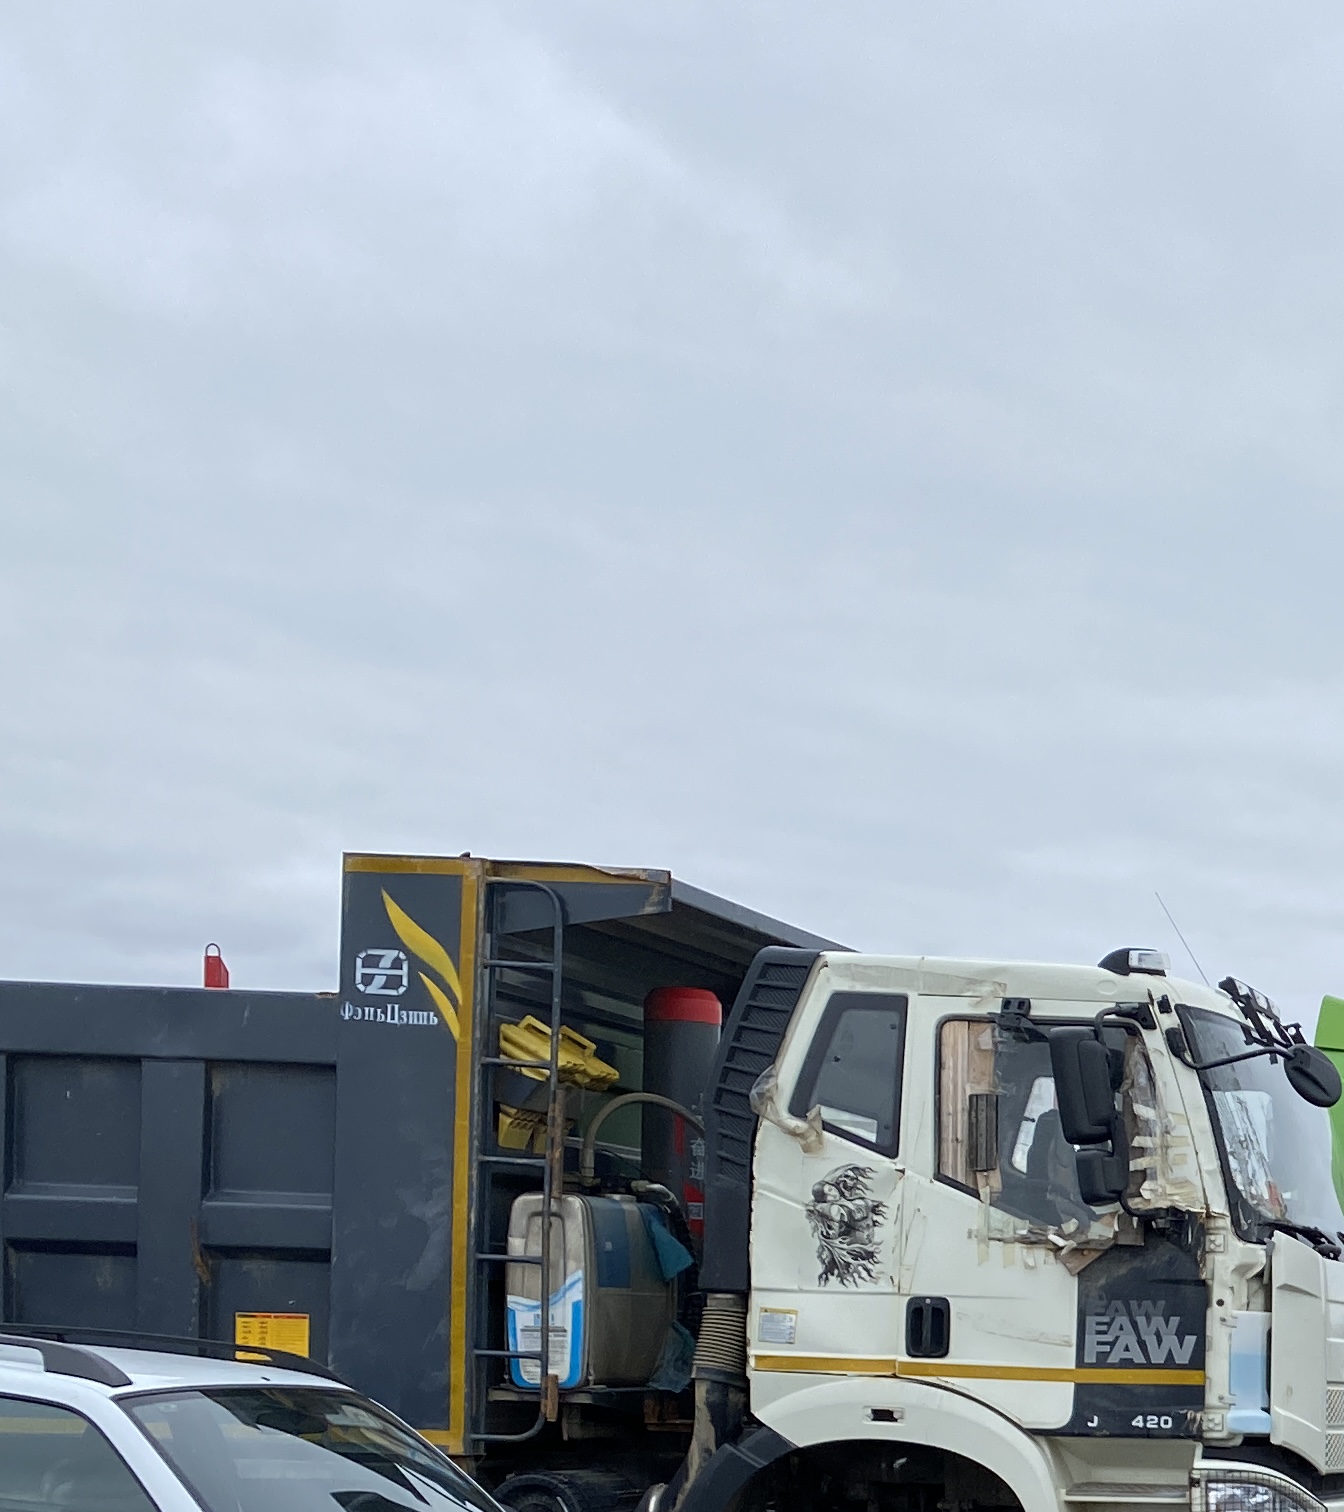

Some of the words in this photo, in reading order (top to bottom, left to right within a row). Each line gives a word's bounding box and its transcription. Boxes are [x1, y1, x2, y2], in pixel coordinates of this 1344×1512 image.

[1085, 1315, 1181, 1338] FAW
[1083, 1334, 1198, 1365] FAW
[1087, 1415, 1099, 1427] J
[1131, 1415, 1173, 1429] 420
